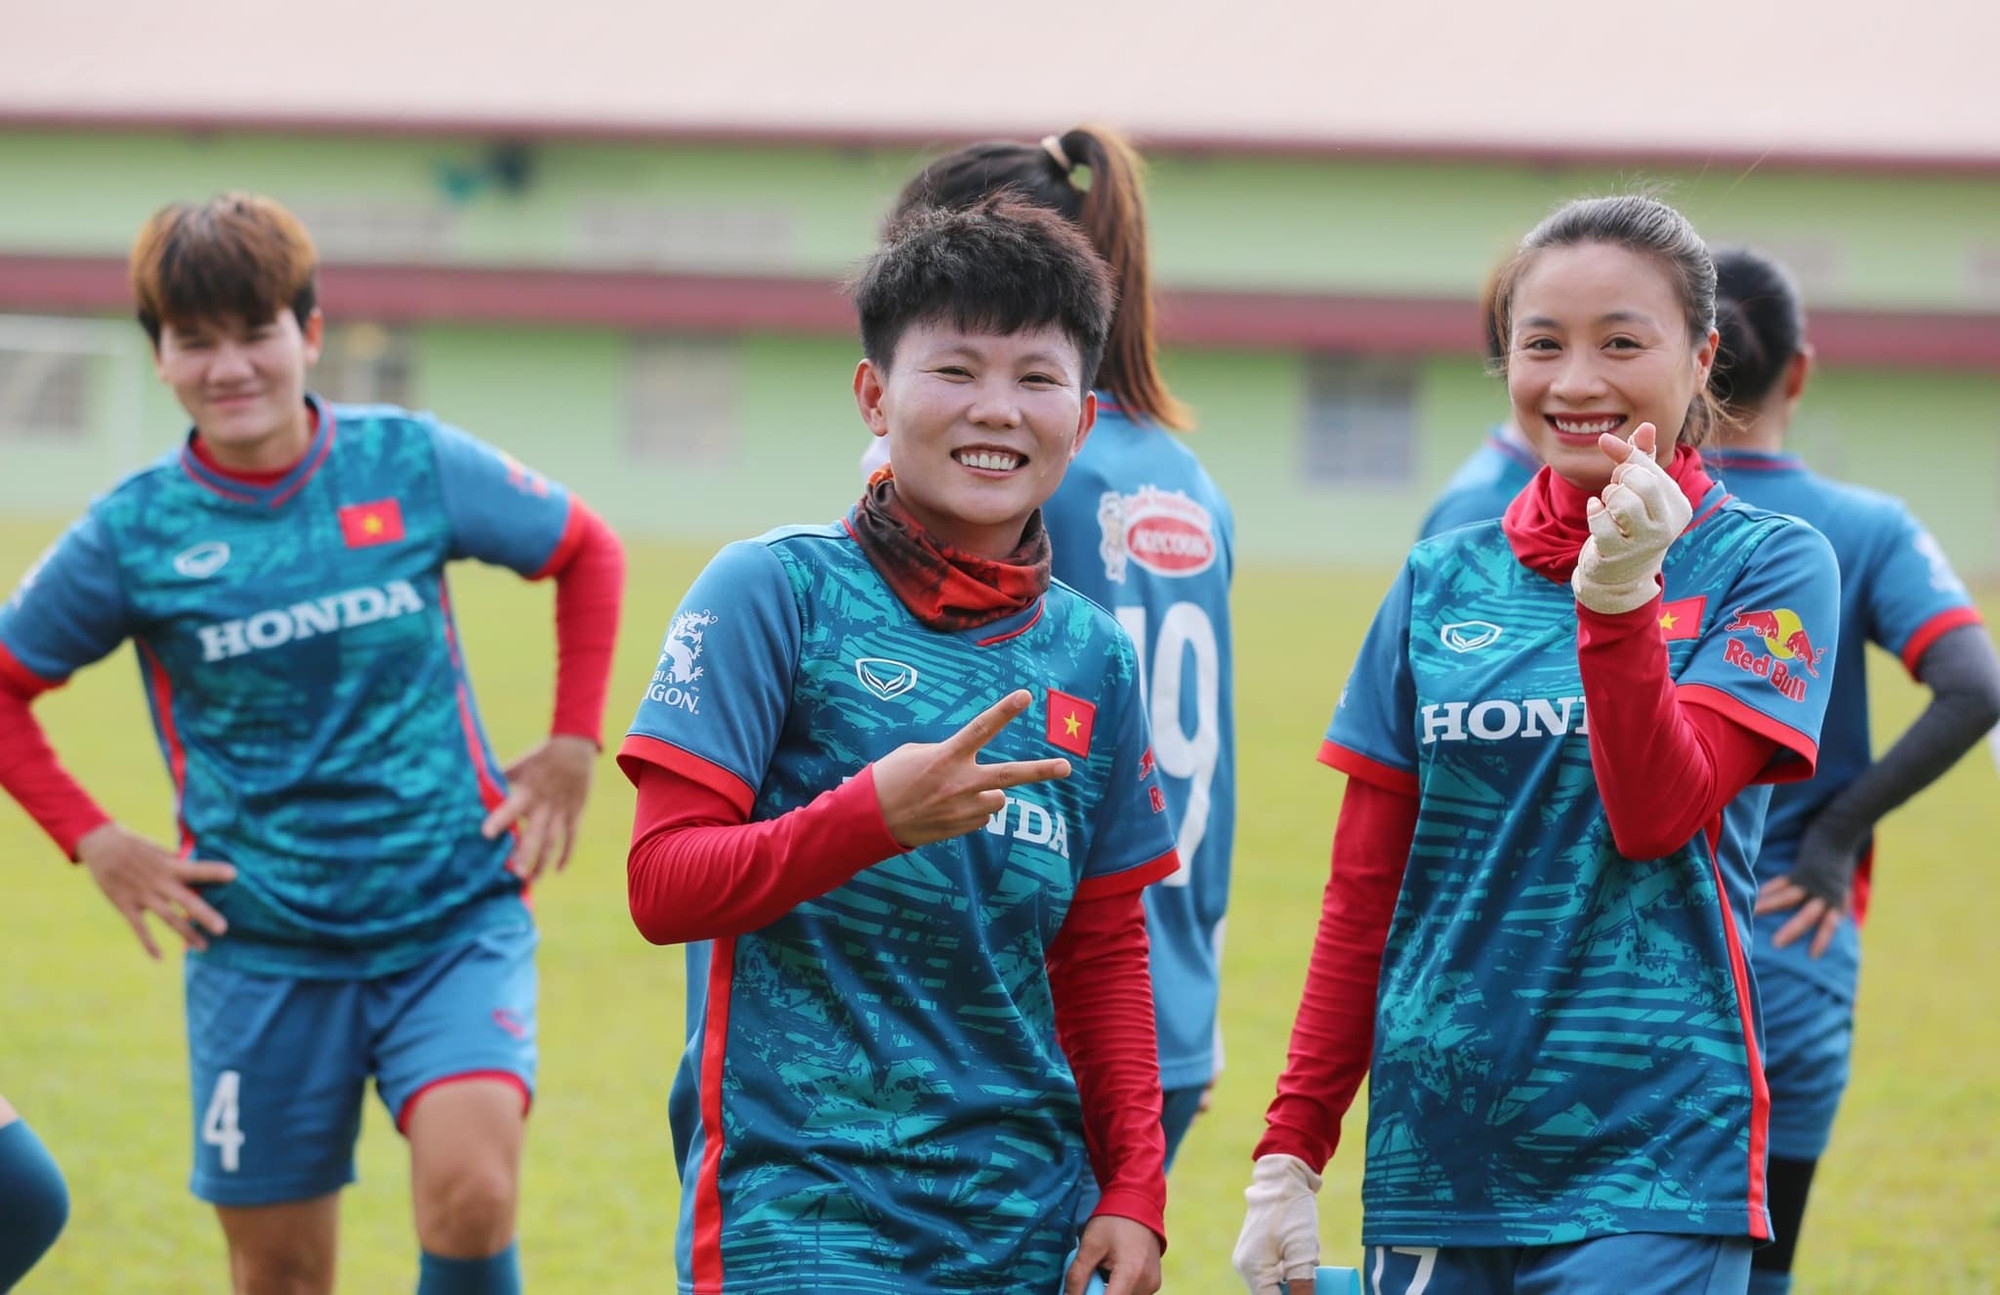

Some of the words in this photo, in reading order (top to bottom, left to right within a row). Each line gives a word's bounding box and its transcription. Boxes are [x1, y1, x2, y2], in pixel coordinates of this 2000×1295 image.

[197, 578, 425, 663] HONDA
[644, 682, 700, 716] IGON.
[1723, 637, 1771, 678] Red
[1769, 659, 1807, 703] Bull
[1115, 601, 1219, 887] 9
[1421, 695, 1589, 745] HON
[980, 796, 1070, 860] NDA
[202, 1069, 246, 1172] 4
